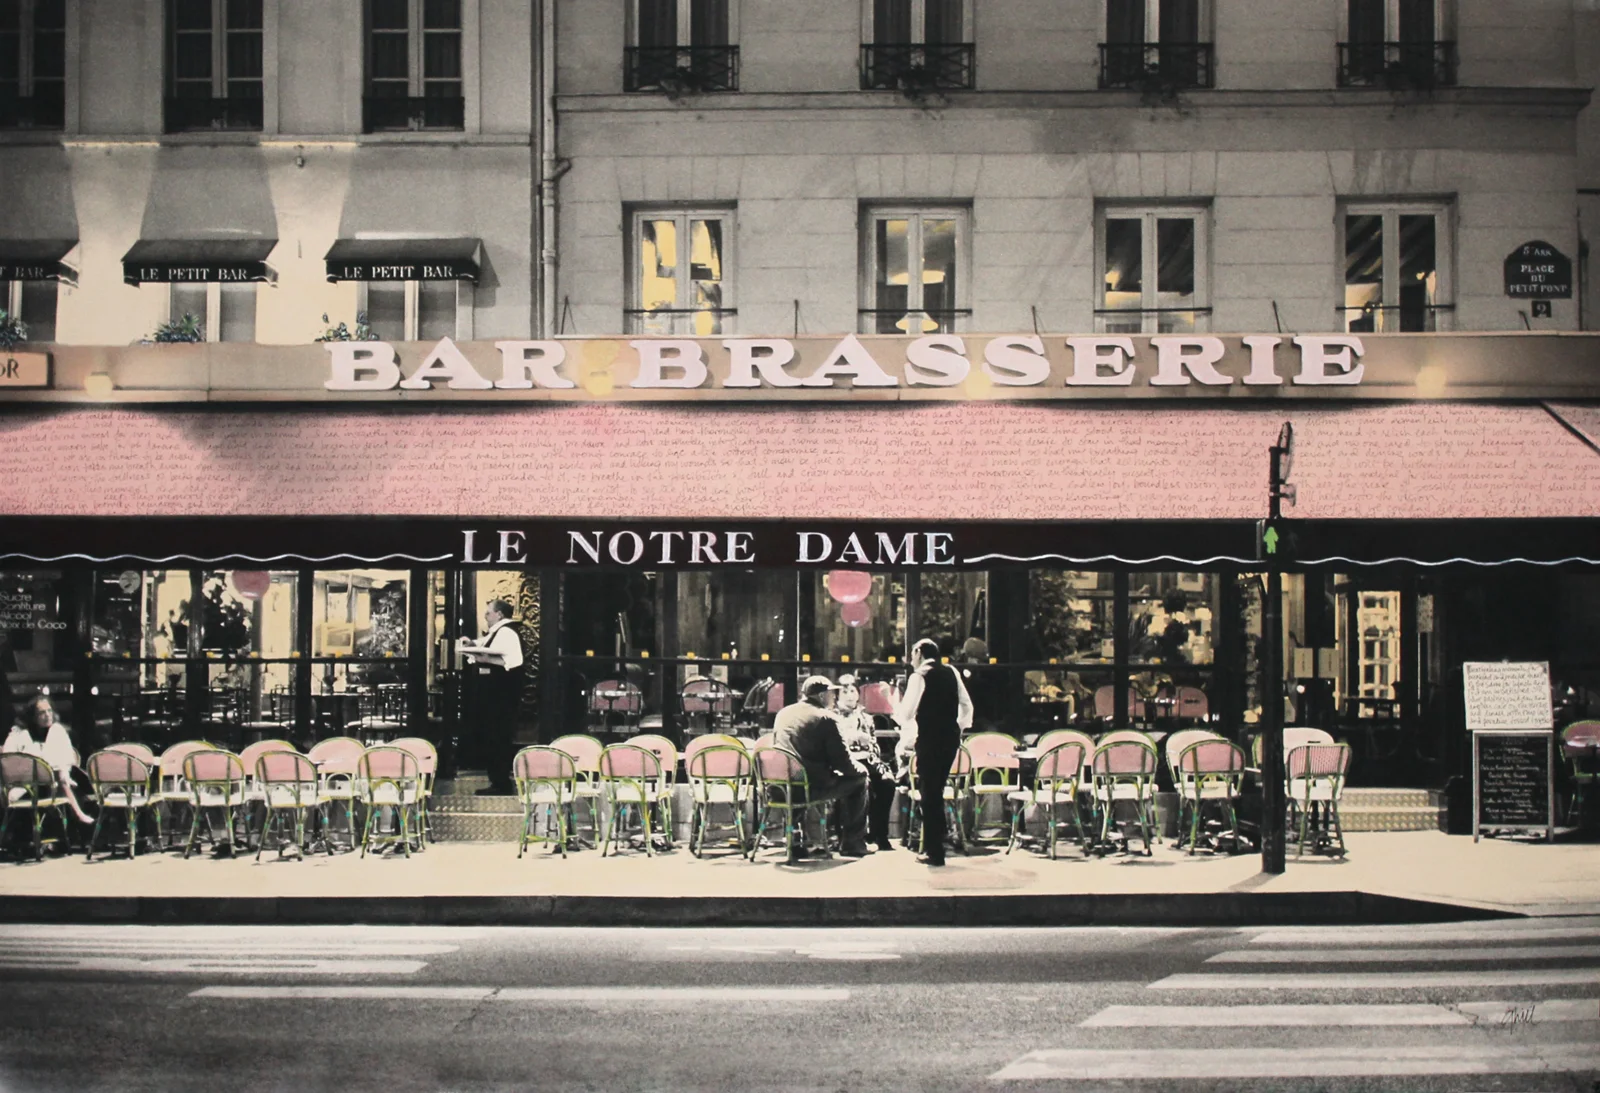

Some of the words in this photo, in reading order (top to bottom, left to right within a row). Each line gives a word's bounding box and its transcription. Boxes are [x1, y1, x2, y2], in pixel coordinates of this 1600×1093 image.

[15, 266, 44, 278] BAR
[140, 268, 159, 280] LE
[168, 268, 210, 280] PETIT
[218, 268, 248, 280] BAR
[344, 266, 363, 278] LE
[371, 265, 415, 278] PETIT
[423, 266, 453, 278] BAR
[1509, 284, 1538, 293] PETIT
[324, 336, 575, 391] BAR
[629, 333, 1366, 389] BRASSERIE
[461, 530, 527, 564] LE
[566, 530, 756, 565] NOTRE
[796, 531, 956, 566] DAME
[37, 619, 67, 629] Coco
